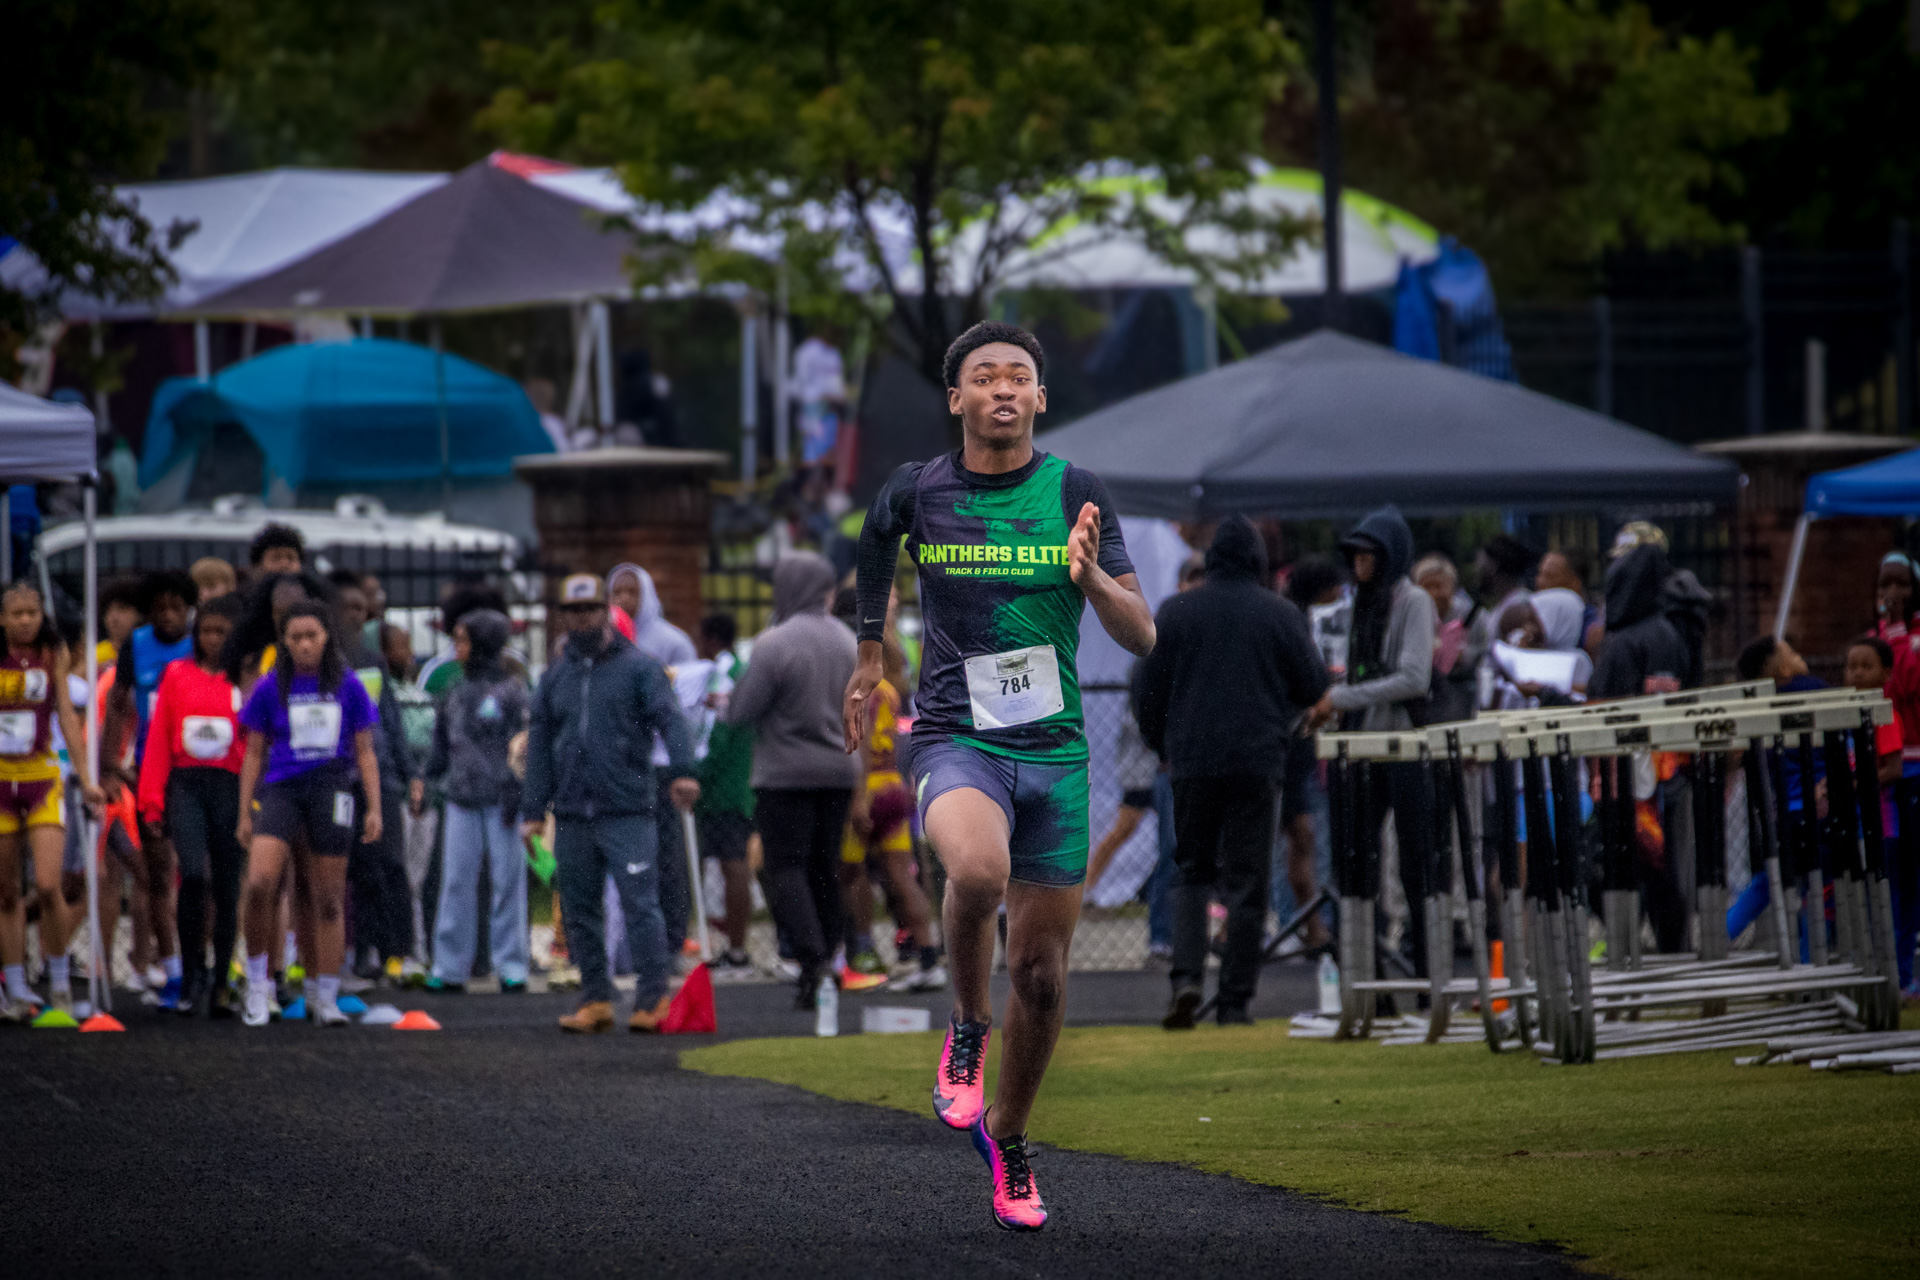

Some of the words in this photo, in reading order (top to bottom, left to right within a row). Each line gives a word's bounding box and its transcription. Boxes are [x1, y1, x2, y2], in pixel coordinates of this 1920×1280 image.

[919, 543, 1012, 564] PANTHERS
[1017, 545, 1071, 566] ELITE
[945, 567, 972, 575] TRACK
[982, 567, 1009, 575] FIELD
[1011, 568, 1034, 576] CLUB
[1000, 674, 1031, 696] 784
